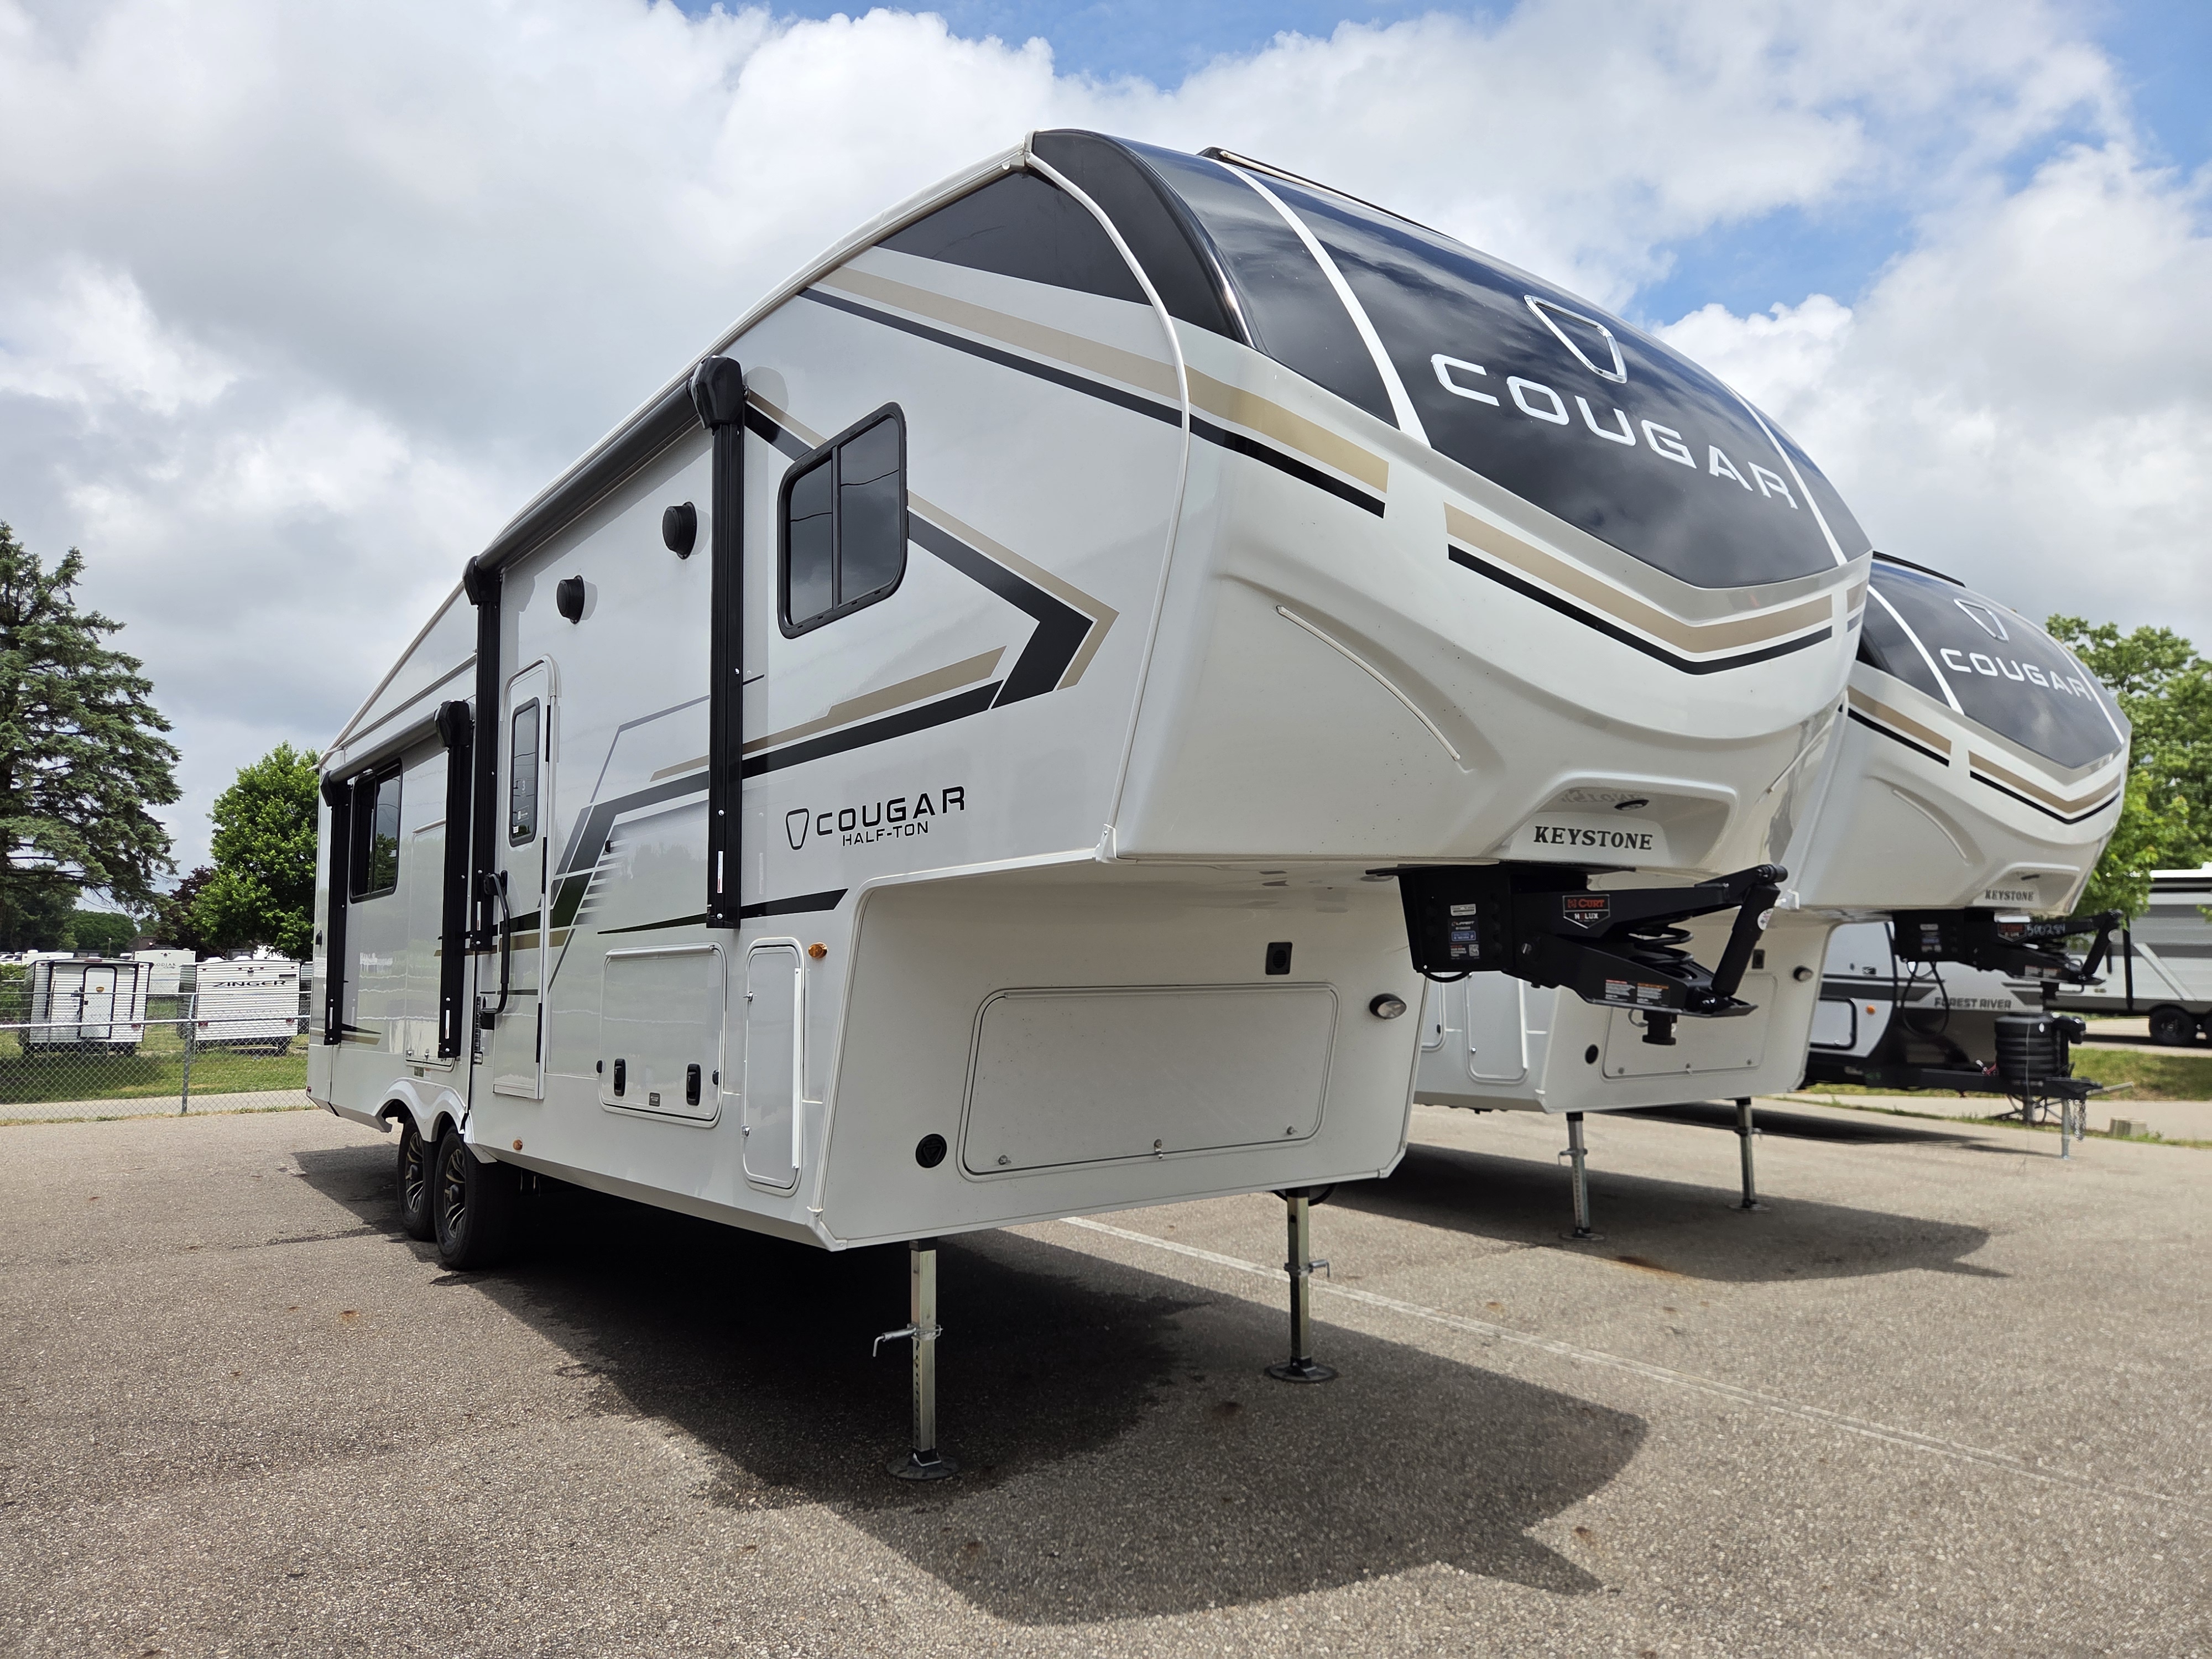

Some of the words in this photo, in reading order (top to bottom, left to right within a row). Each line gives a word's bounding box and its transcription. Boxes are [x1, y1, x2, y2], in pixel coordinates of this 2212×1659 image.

[1431, 353, 1798, 510] COUGAR
[1940, 648, 2092, 702] COUGAR
[816, 786, 965, 836] COUGAR
[842, 821, 928, 847] HALF-TON
[1533, 826, 1653, 851] KEYSTONE
[1985, 889, 2034, 902] KEYSTONE
[1979, 998, 2012, 1009] RIVER
